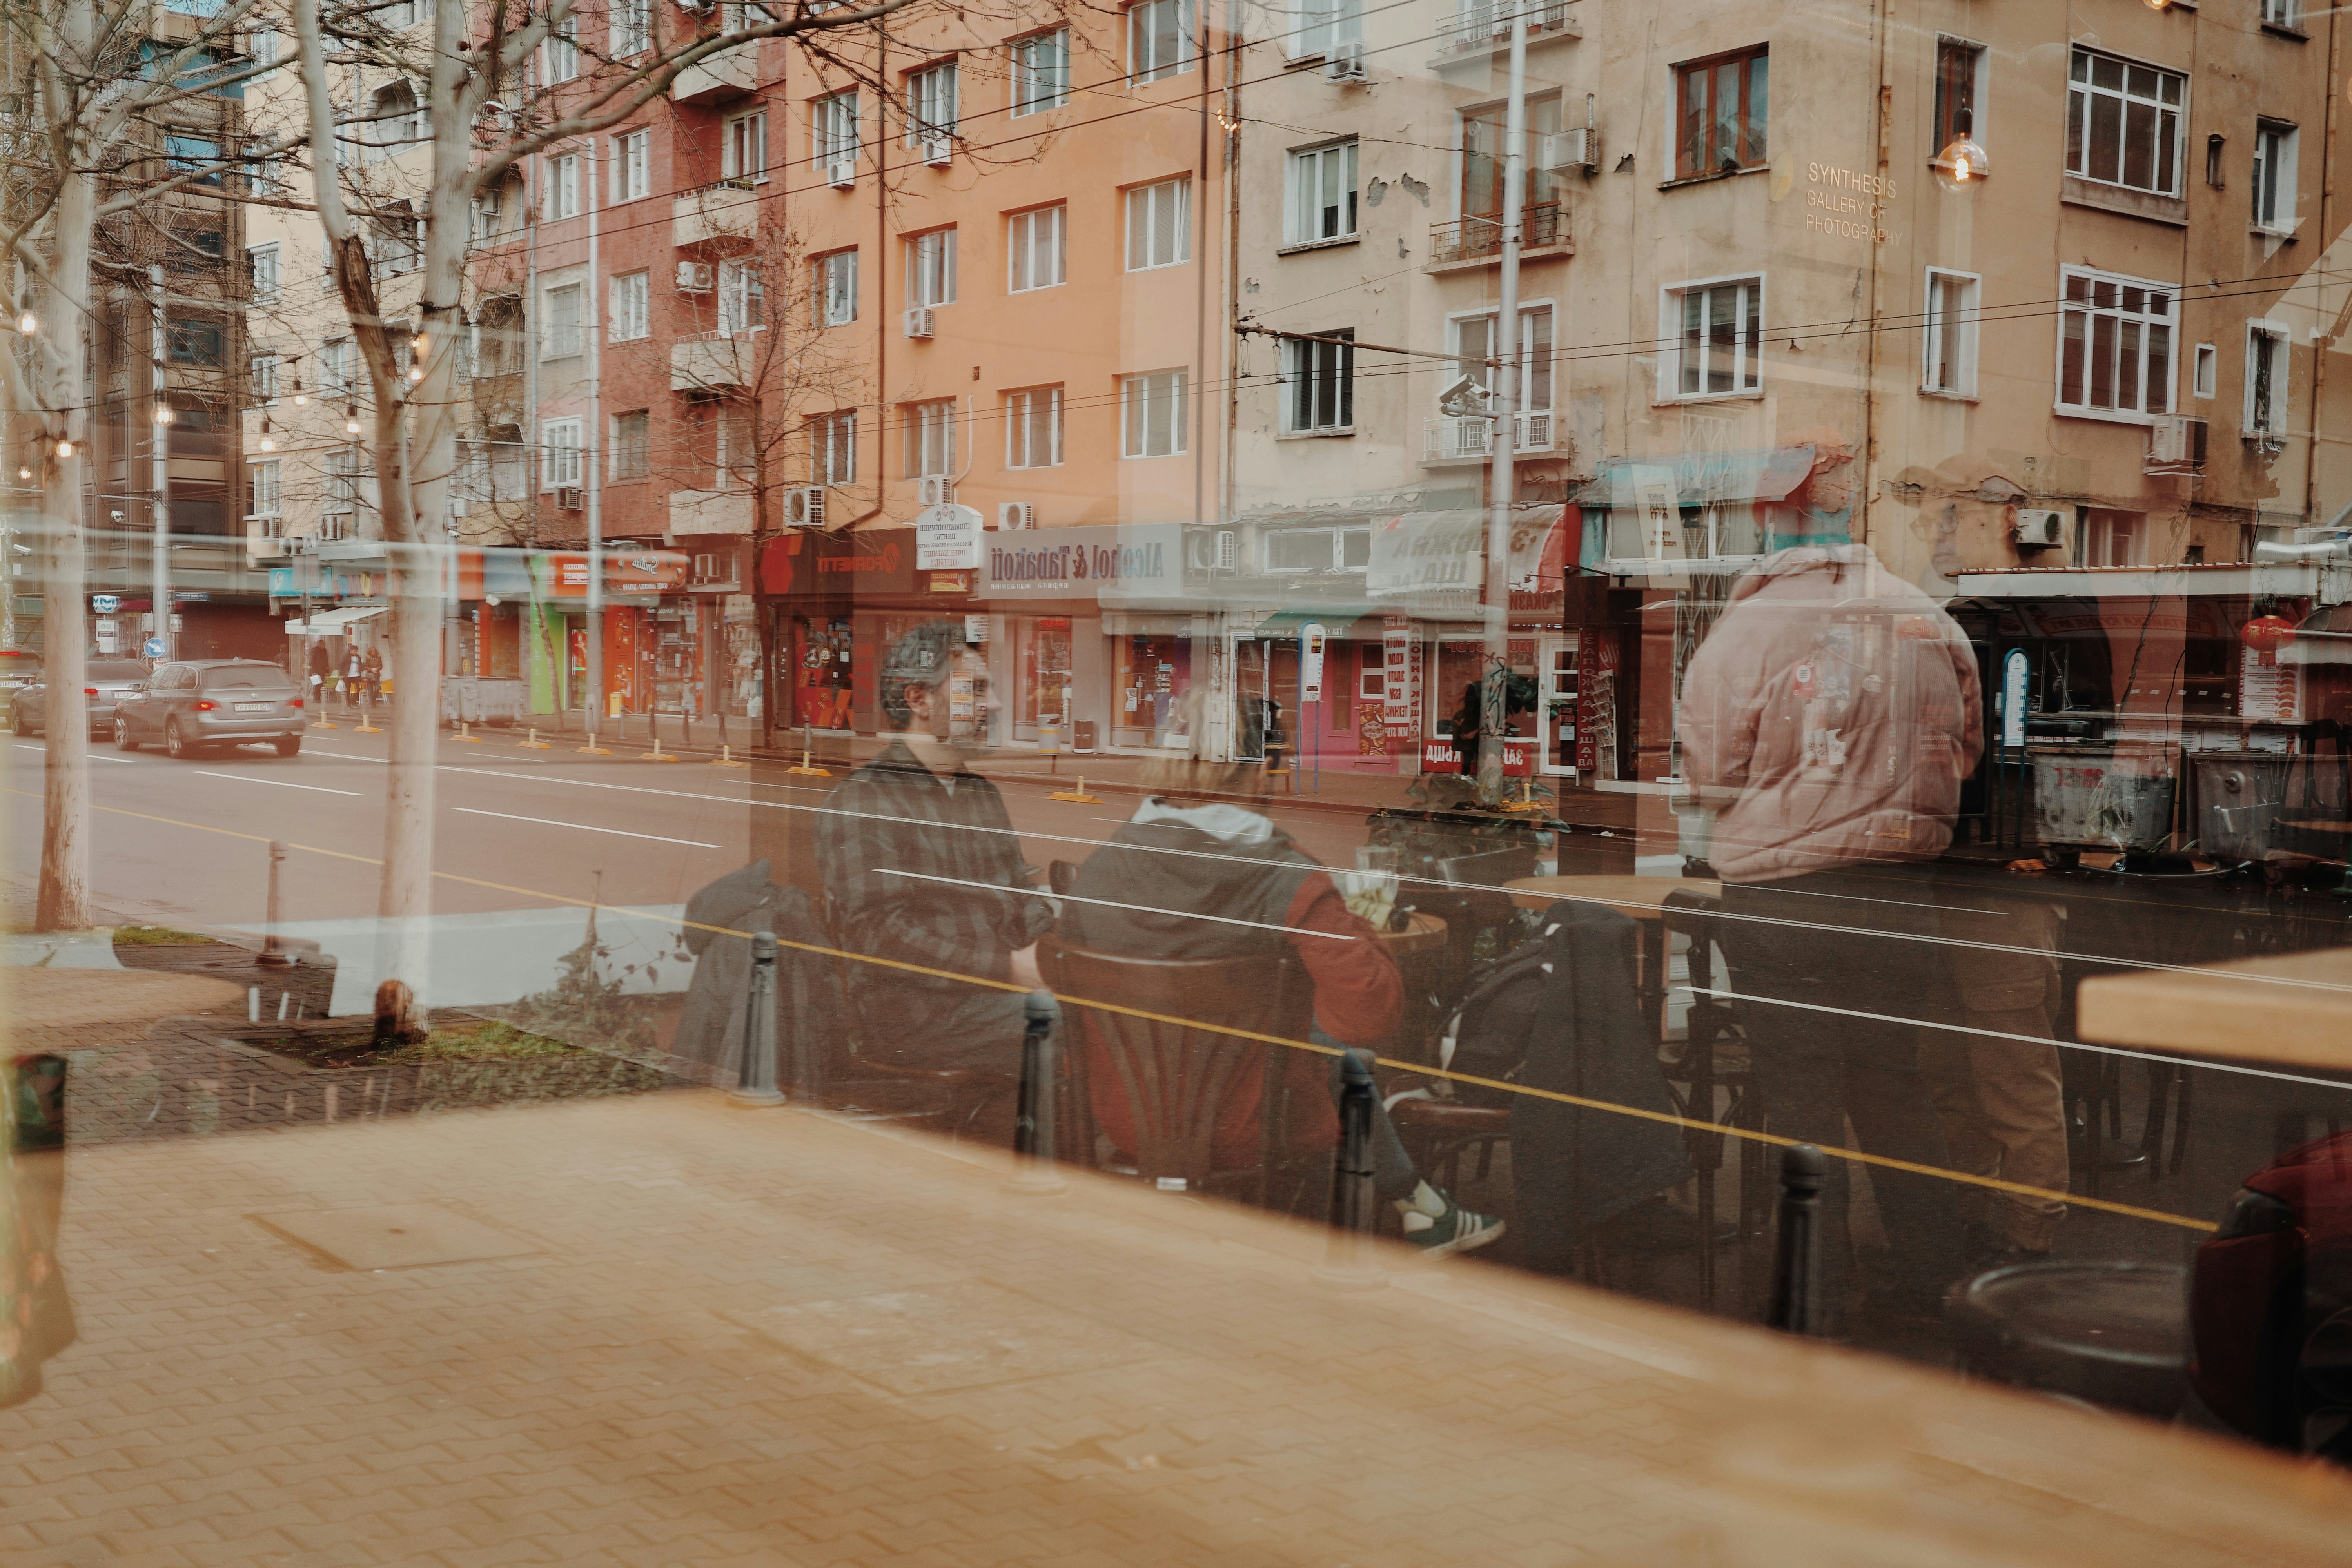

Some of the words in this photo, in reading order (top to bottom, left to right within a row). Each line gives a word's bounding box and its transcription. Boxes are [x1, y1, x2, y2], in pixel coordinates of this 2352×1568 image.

[1809, 162, 1896, 199] SYNTHESIS
[1807, 189, 1864, 216] GALLERY
[1869, 203, 1886, 220] OF
[1806, 214, 1902, 247] PHOTOGRAPHY
